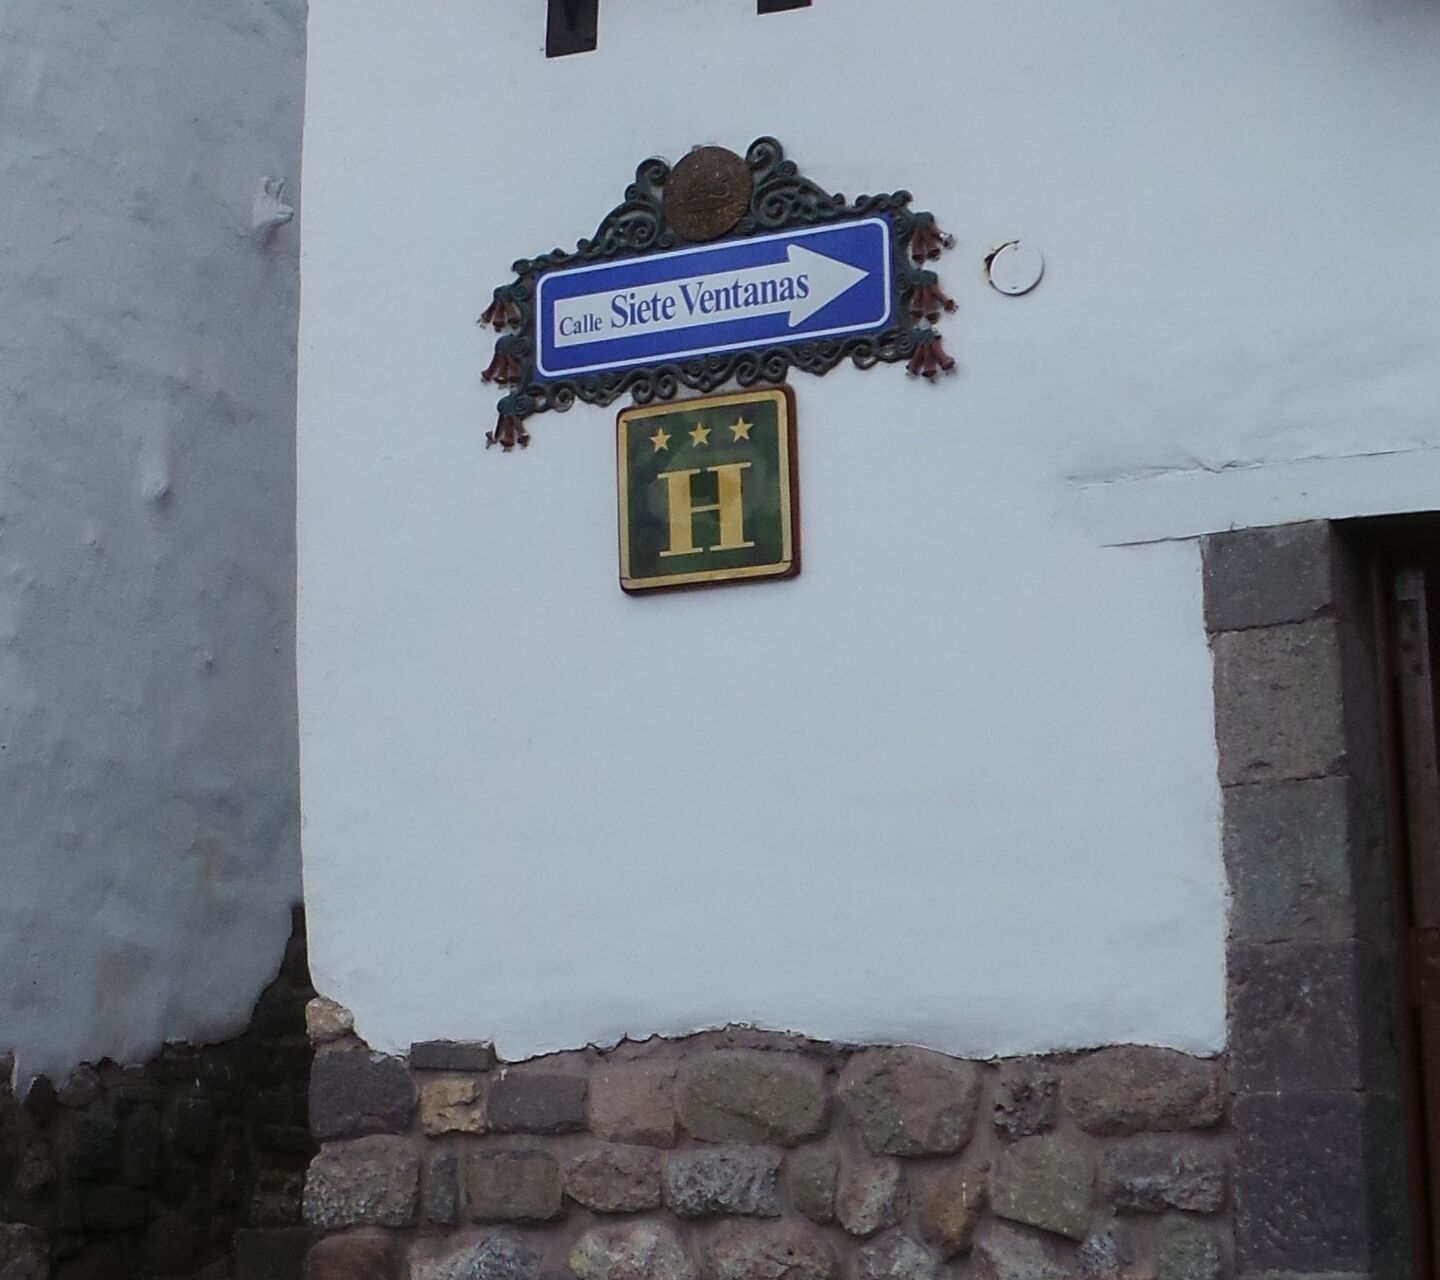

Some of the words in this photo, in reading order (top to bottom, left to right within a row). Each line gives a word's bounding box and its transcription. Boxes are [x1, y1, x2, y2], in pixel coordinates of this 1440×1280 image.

[559, 313, 603, 337] Calle
[611, 291, 676, 329] Siete
[678, 273, 809, 317] Ventanas
[657, 462, 755, 558] H
